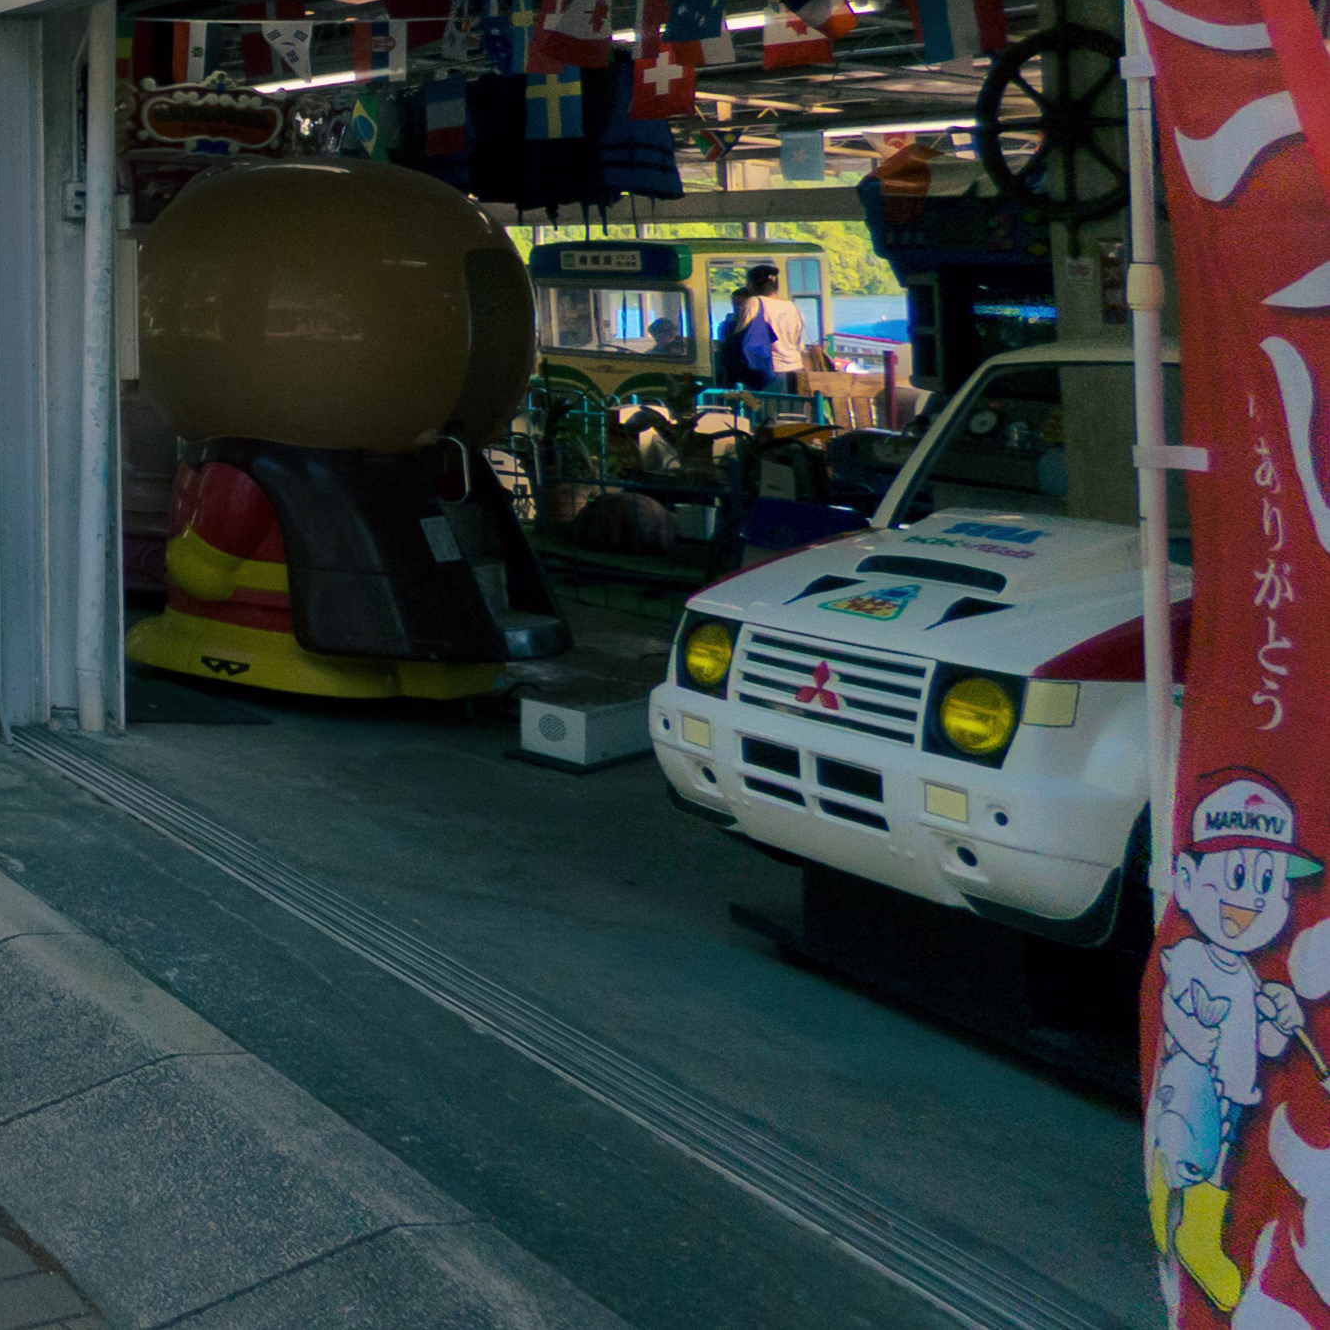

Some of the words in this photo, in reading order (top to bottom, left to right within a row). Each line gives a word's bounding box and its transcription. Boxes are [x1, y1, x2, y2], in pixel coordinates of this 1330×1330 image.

[1253, 435, 1297, 731] ありがとう
[1205, 811, 1286, 835] MARUKYU
